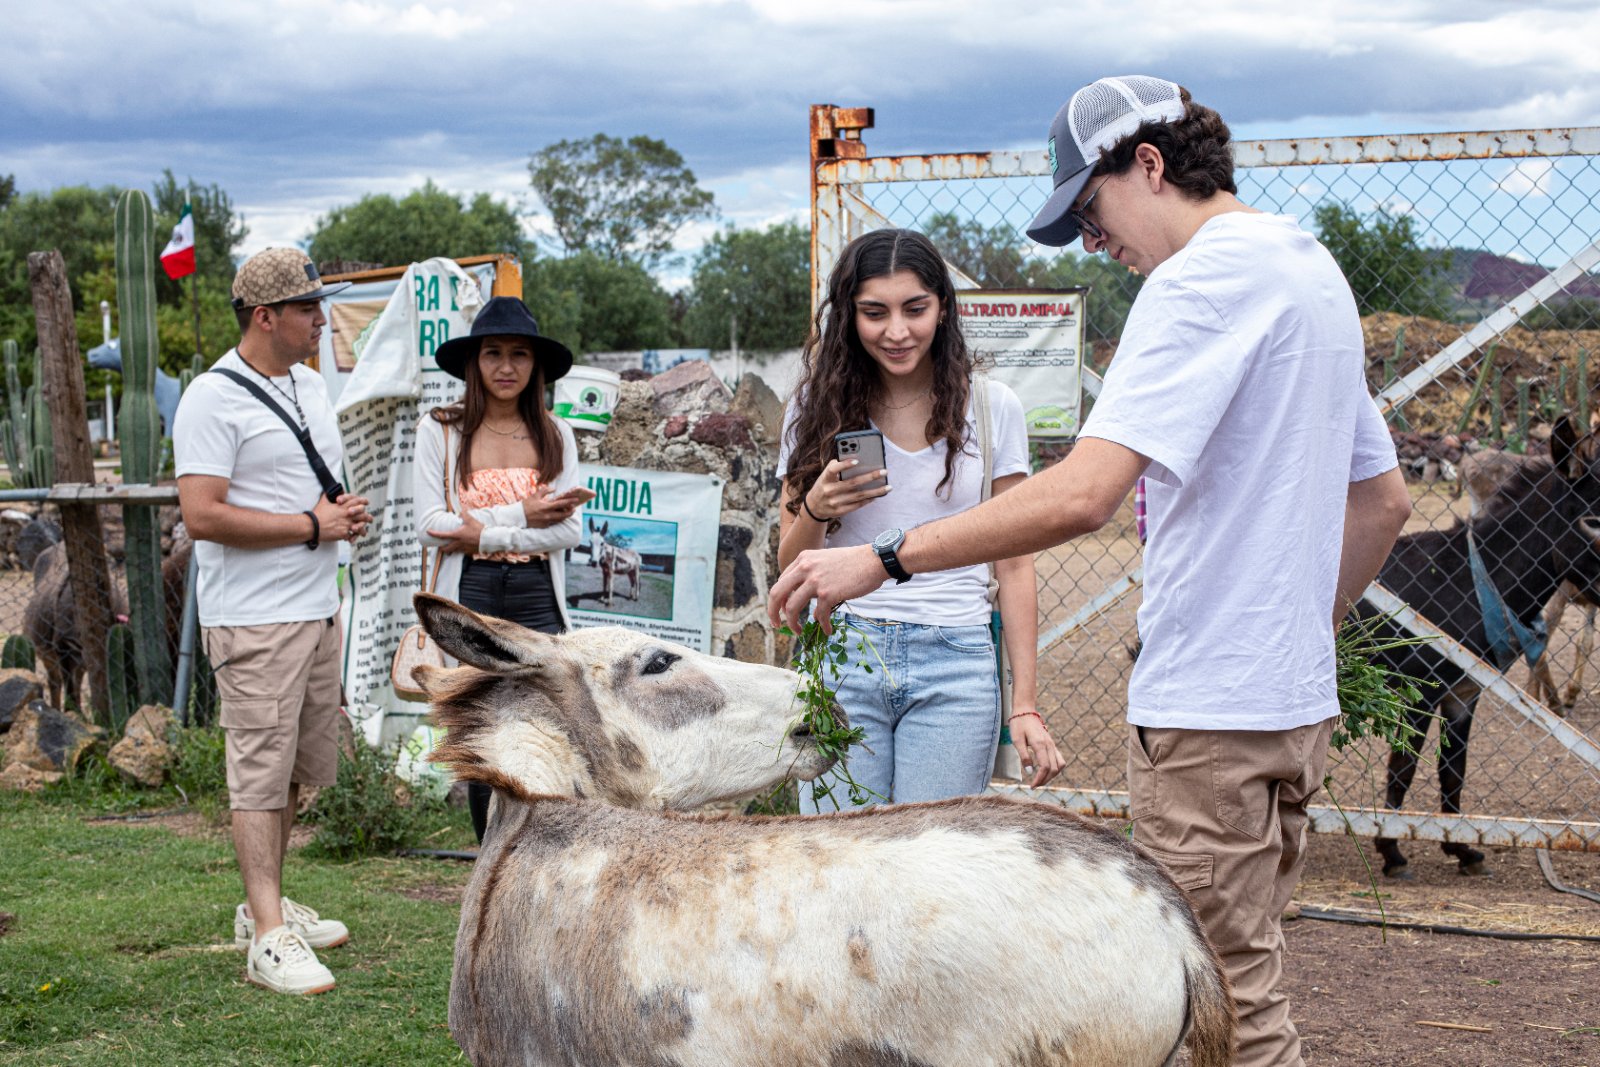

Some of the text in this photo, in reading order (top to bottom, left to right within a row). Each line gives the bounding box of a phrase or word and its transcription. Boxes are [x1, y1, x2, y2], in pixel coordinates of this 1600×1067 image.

[1020, 303, 1074, 317] ANIMAL
[1046, 348, 1075, 357] animales
[586, 476, 652, 515] INDIA
[394, 565, 409, 574] los
